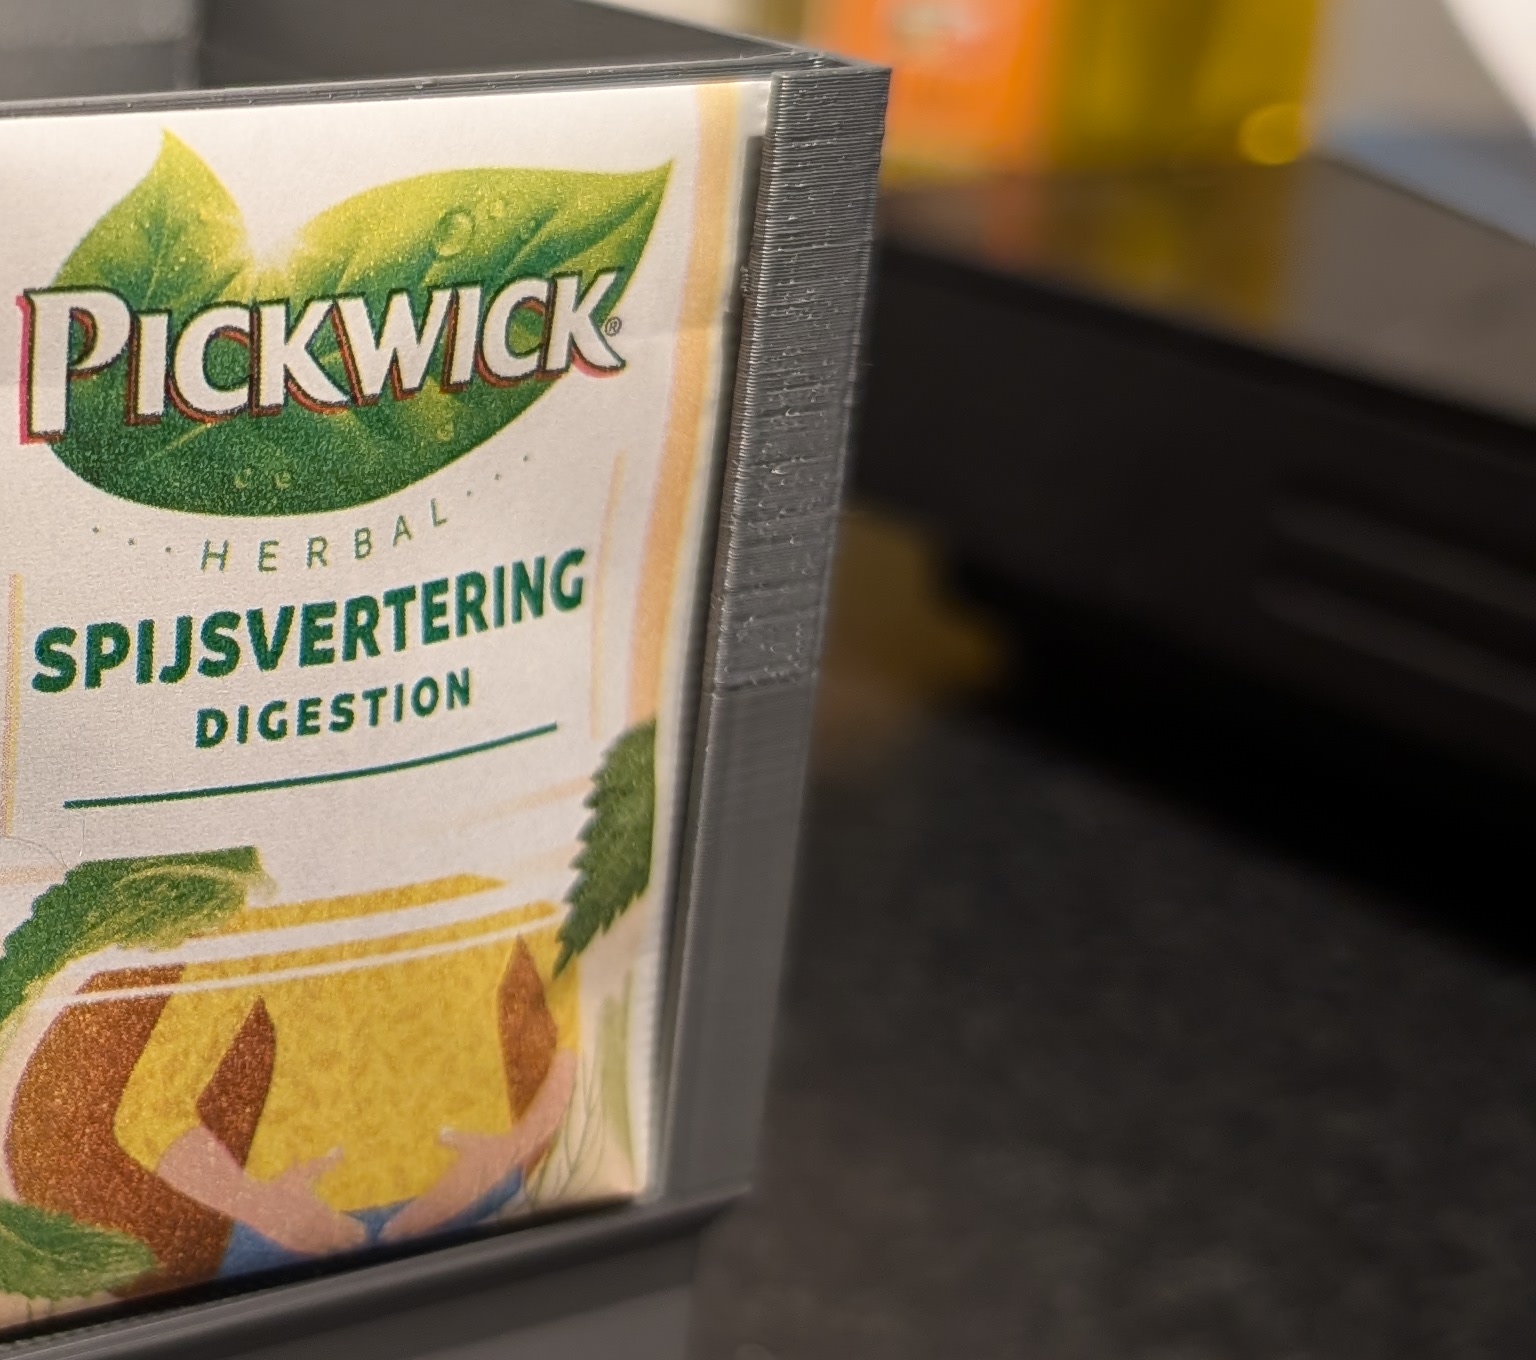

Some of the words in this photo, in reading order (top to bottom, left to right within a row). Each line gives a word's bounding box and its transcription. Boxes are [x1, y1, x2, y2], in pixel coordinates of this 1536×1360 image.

[19, 267, 626, 444] PICKWICK
[201, 498, 450, 573] HERBAL
[31, 549, 586, 693] SPIJSVERTERING
[194, 669, 472, 749] DIGESTION
